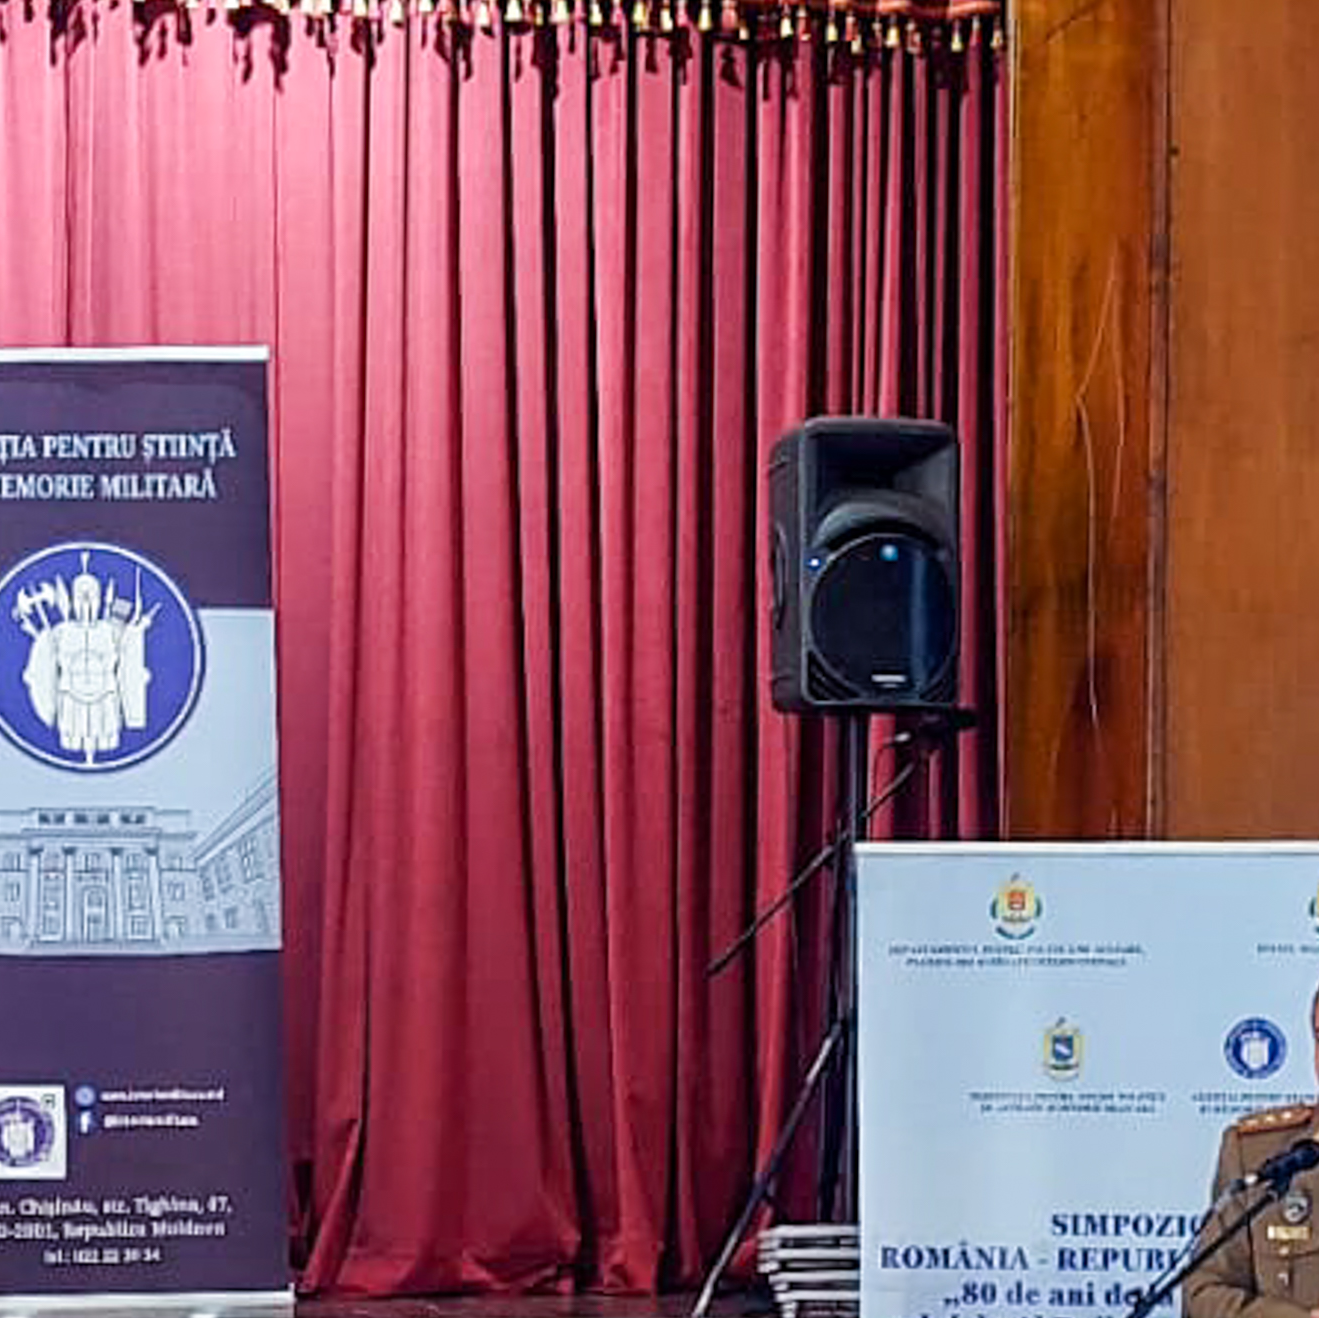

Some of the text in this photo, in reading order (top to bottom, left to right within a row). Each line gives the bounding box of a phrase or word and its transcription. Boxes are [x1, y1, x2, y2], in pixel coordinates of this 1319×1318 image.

[42, 433, 136, 459] PENTRU
[101, 467, 216, 499] MILITARĂ
[880, 1240, 1030, 1271] ROMÂNIA
[1005, 1280, 1041, 1307] de
[1047, 1280, 1095, 1308] ani
